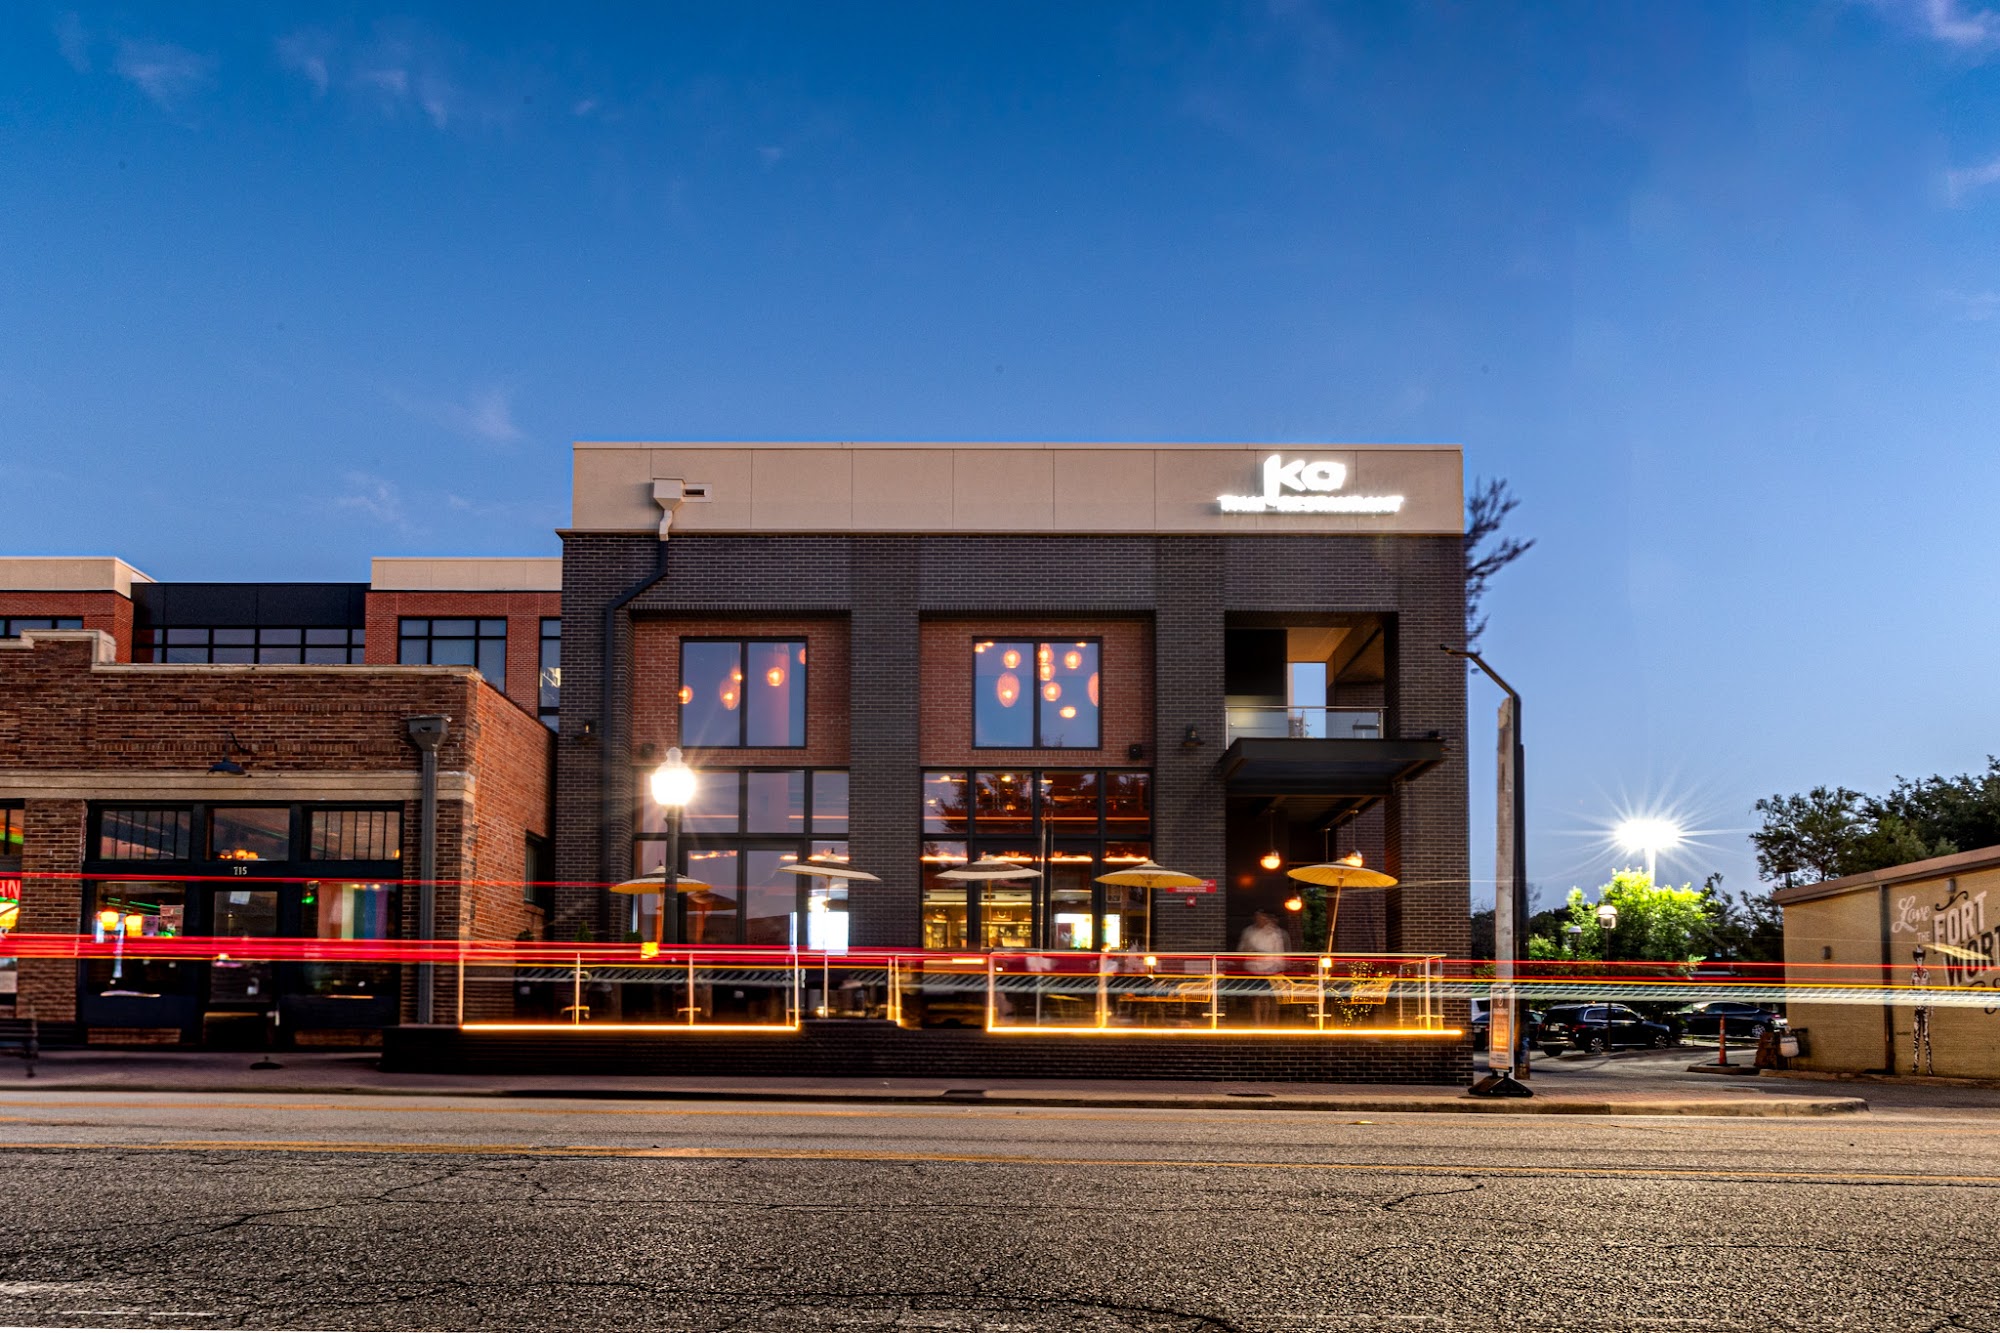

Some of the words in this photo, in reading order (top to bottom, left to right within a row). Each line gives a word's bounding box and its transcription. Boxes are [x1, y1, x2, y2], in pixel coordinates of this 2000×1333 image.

[233, 866, 248, 876] 715
[1891, 895, 1931, 933] Love
[1933, 890, 1988, 954] FORT
[1916, 931, 1931, 943] THE
